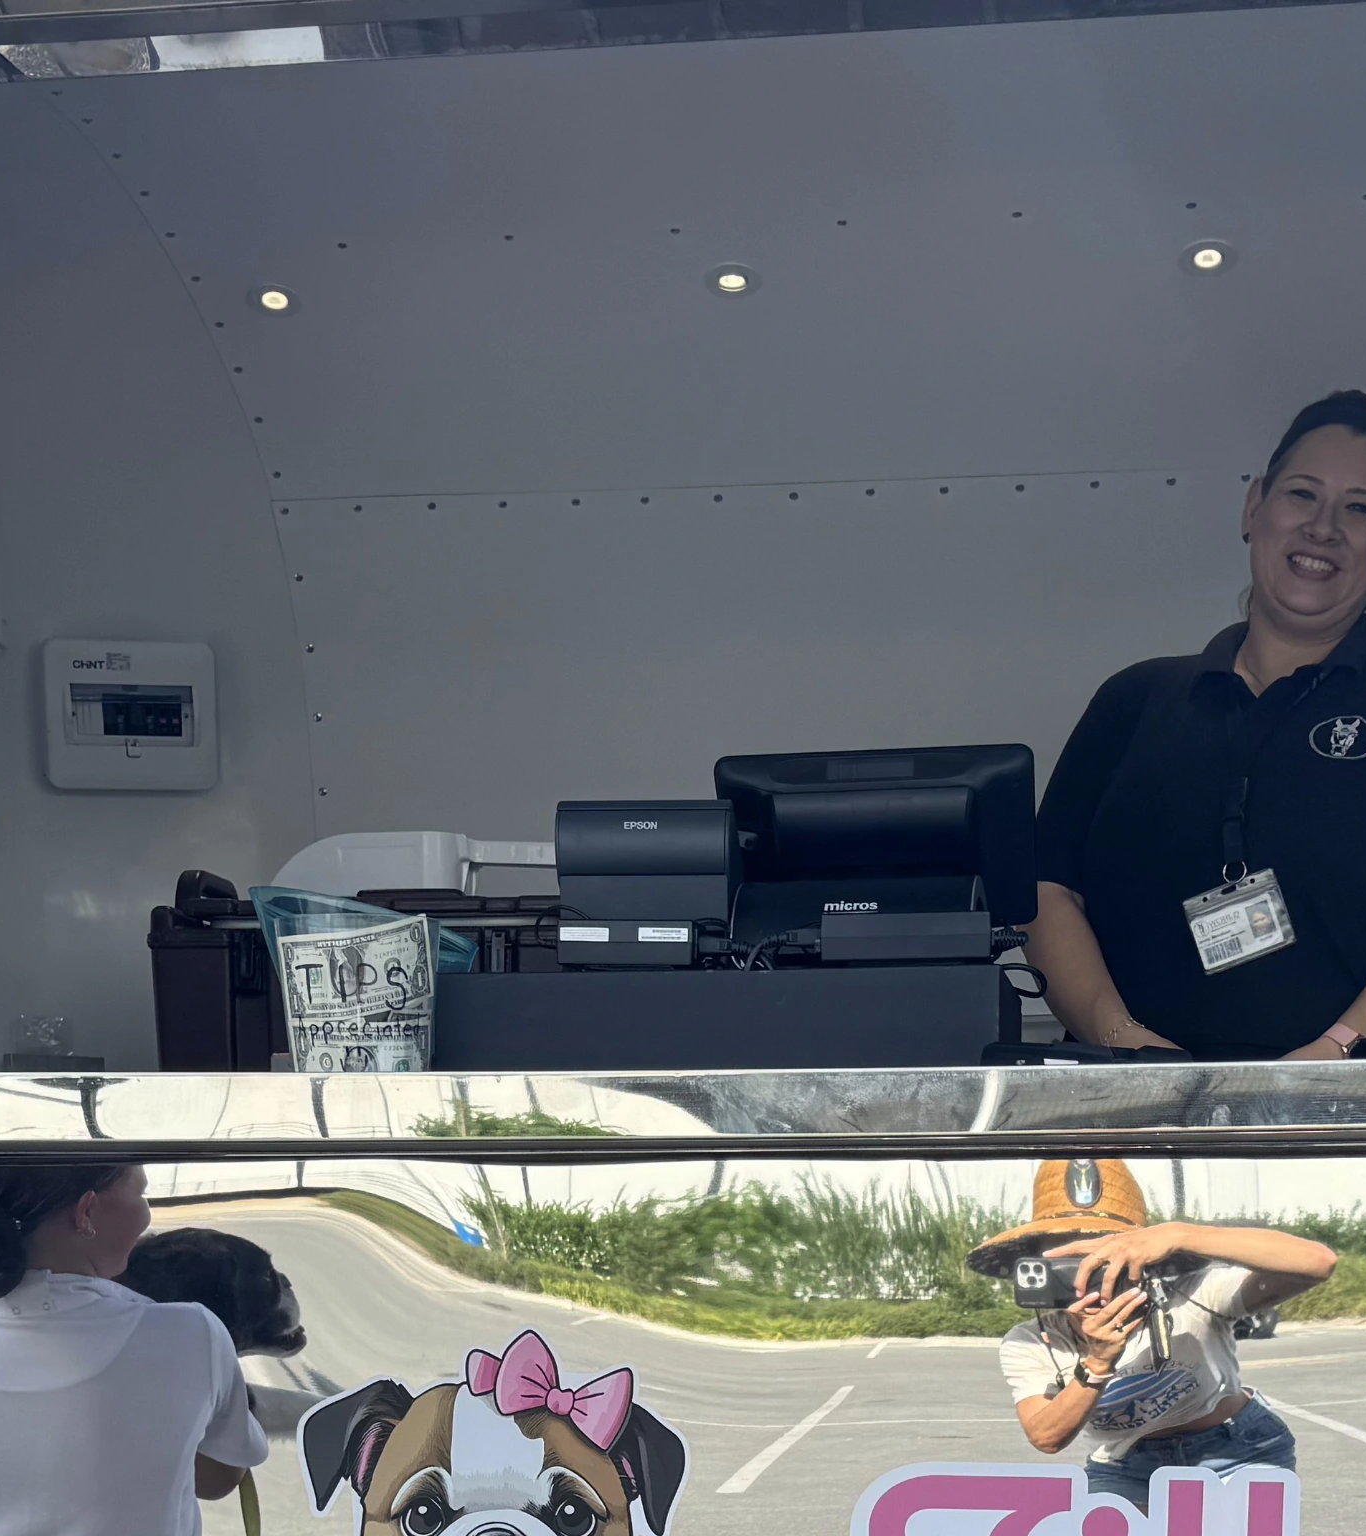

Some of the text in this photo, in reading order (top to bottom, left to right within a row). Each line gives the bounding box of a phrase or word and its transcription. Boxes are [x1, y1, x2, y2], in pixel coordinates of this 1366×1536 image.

[623, 821, 658, 830] EPSON
[823, 900, 878, 911] micros
[295, 963, 409, 1010] TIPS
